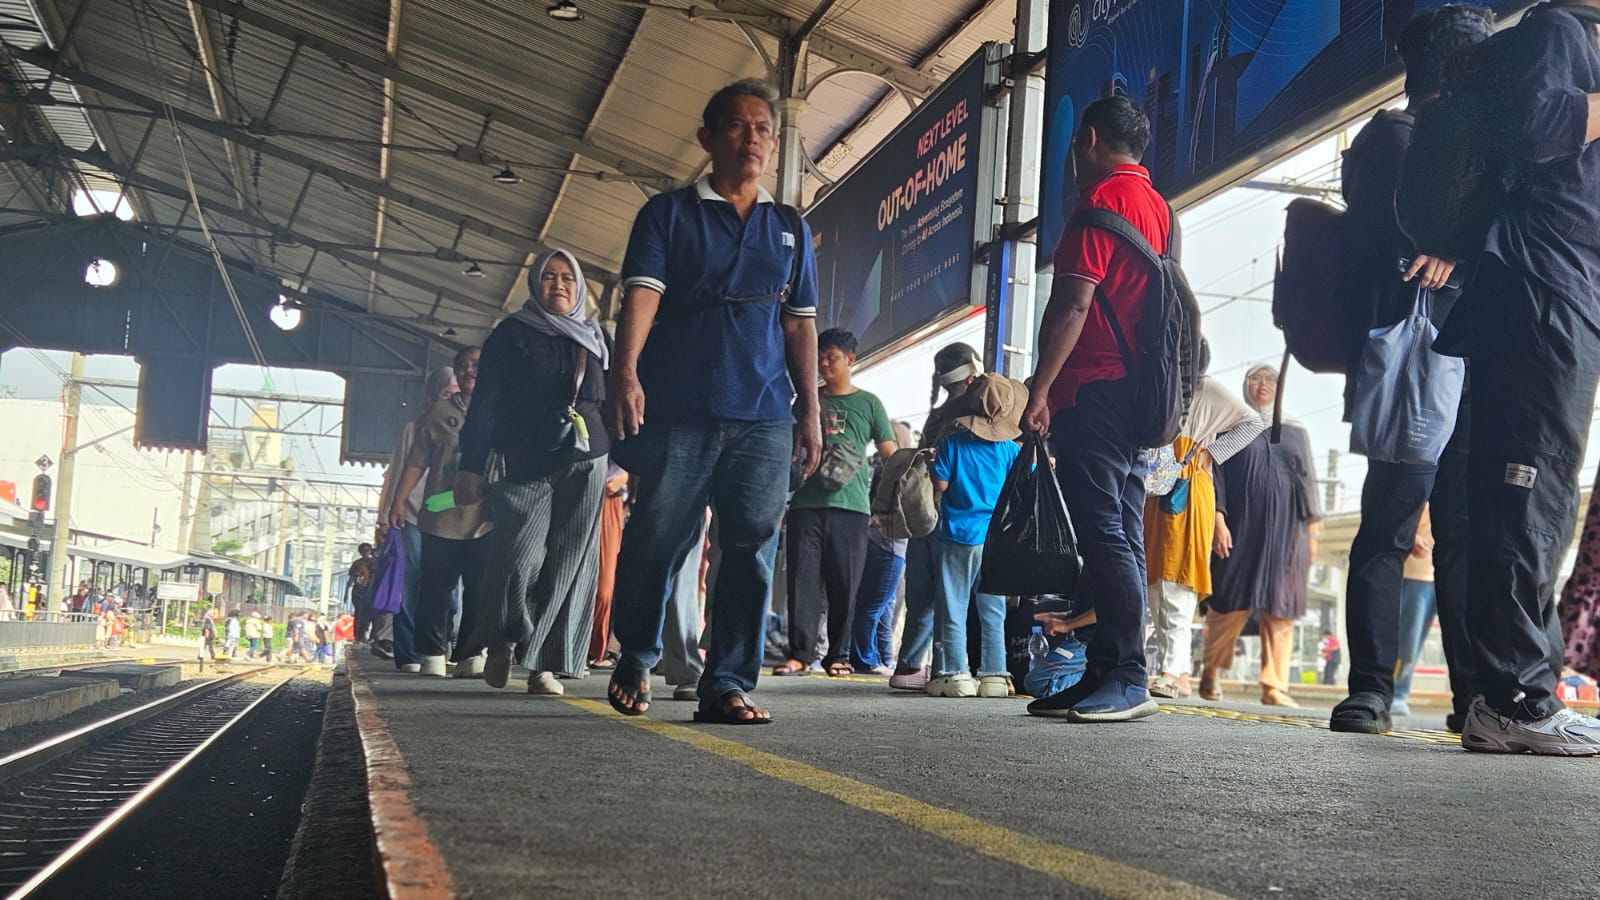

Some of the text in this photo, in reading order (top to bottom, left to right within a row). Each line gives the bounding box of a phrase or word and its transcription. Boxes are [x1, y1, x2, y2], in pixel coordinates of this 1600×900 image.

[917, 98, 969, 159] NEXT LEVEL
[878, 132, 968, 231] OUT-OF-HOME
[917, 205, 941, 229] Advertising
[940, 188, 964, 212] Ecosystem
[928, 220, 942, 238] Across
[40, 456, 49, 470] 3
